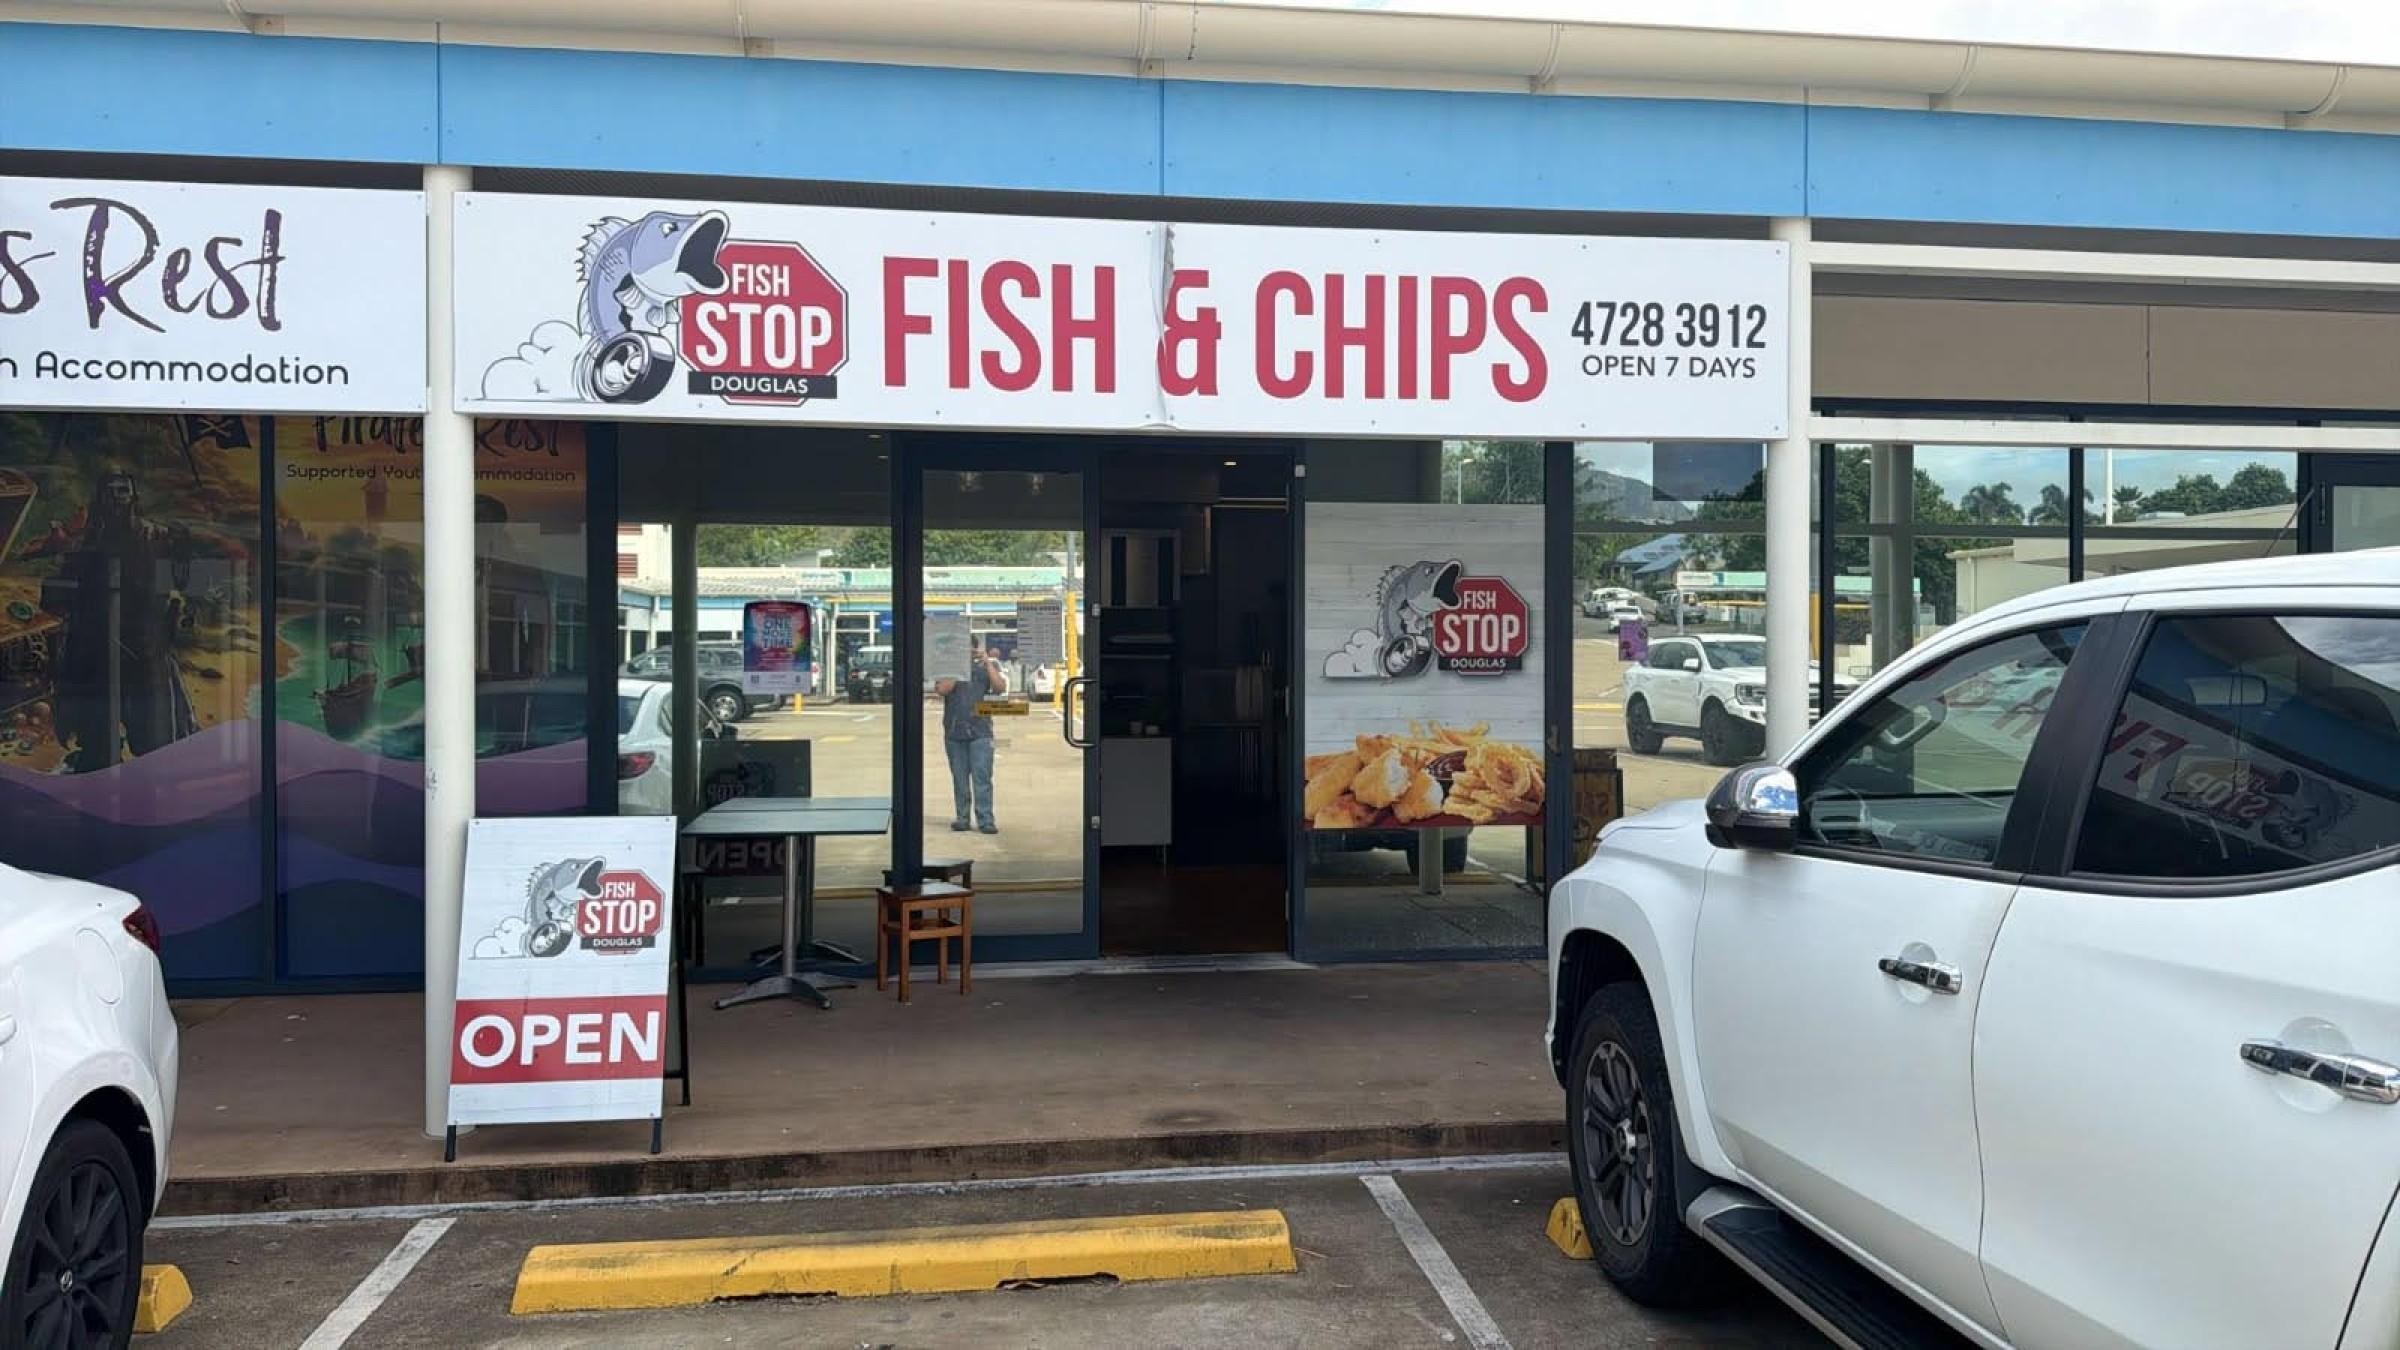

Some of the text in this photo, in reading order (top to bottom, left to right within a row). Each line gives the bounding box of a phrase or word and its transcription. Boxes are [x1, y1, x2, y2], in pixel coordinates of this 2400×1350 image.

[50, 197, 286, 333] Rest
[732, 263, 790, 297] FISH
[695, 304, 833, 370] STOP
[884, 257, 1548, 402] FISH & CHIPS
[1571, 301, 1767, 349] 4728 3912
[35, 350, 349, 385] Accommodation
[1582, 354, 1756, 379] OPEN 7 DAYS
[711, 376, 808, 394] DOUGLAS
[287, 464, 376, 480] Supported
[384, 464, 423, 479] Yout
[1463, 590, 1496, 609] FISH
[1442, 613, 1520, 653] STOP
[1450, 657, 1506, 668] DOUGLAS
[605, 881, 635, 898] FISH
[584, 900, 656, 934] STOP
[592, 937, 643, 948] DOUGLAS
[460, 1011, 661, 1067] OPEN
